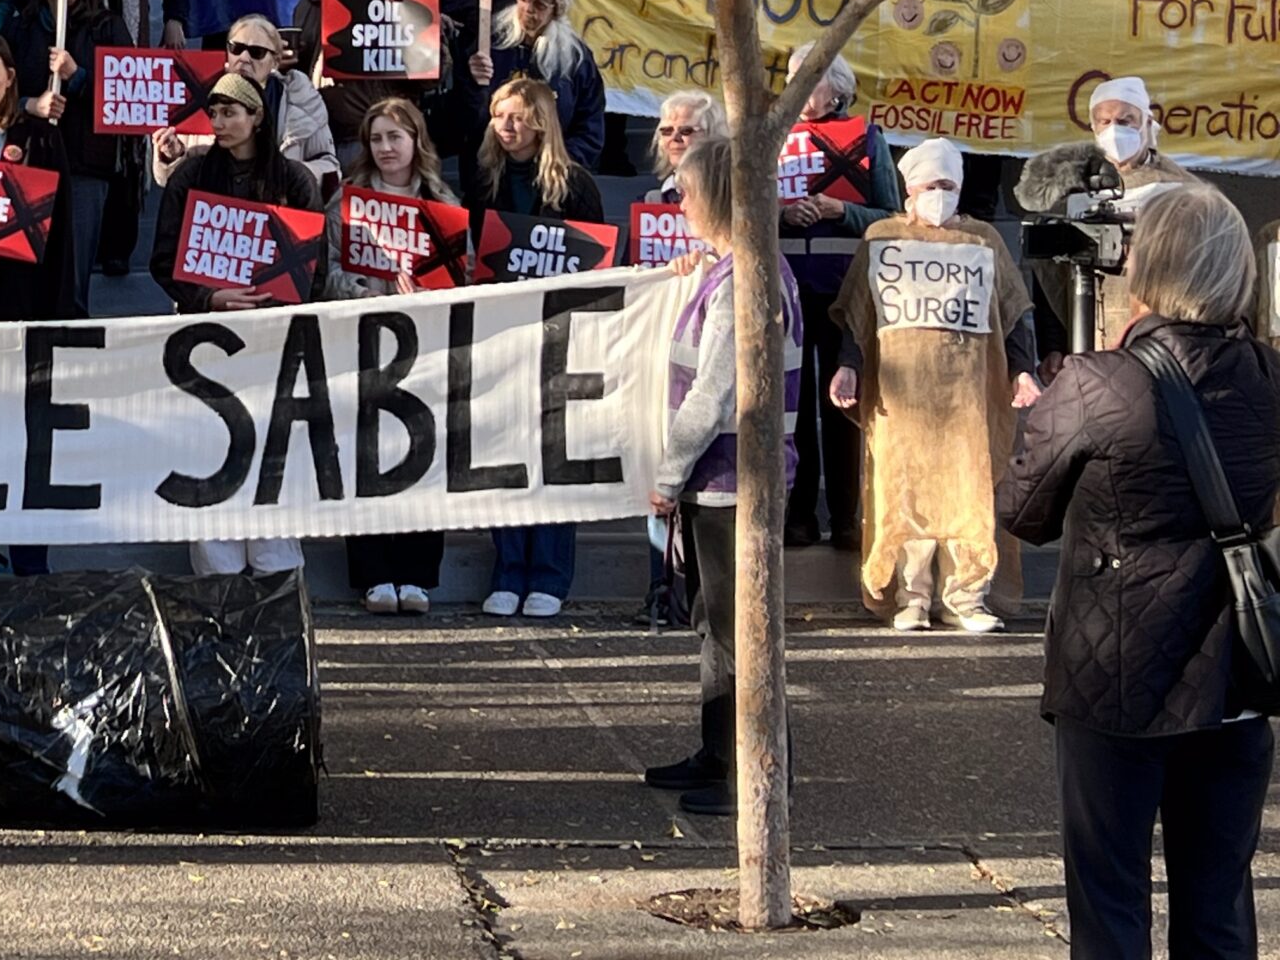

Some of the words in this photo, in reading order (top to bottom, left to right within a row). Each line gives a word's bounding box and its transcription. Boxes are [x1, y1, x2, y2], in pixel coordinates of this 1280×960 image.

[367, 0, 402, 23] OIL
[352, 23, 414, 47] SPILLS
[103, 55, 174, 80] DON'T
[363, 48, 406, 71] KILL
[104, 79, 186, 104] ENABLE
[890, 80, 959, 104] ACT
[961, 83, 1024, 115] NOW
[103, 101, 168, 126] SABLE
[871, 104, 950, 134] FOSSIL
[954, 113, 1017, 139] FREE
[193, 200, 269, 237] DON'T
[349, 195, 419, 230] DON'T
[640, 212, 691, 237] DON
[188, 224, 277, 265] ENABLE
[349, 219, 430, 257] ENABLE
[530, 224, 567, 253] OIL
[183, 249, 255, 286] SABLE
[349, 242, 413, 276] SABLE
[507, 247, 580, 276] SPILLS
[155, 286, 625, 509] SABLE
